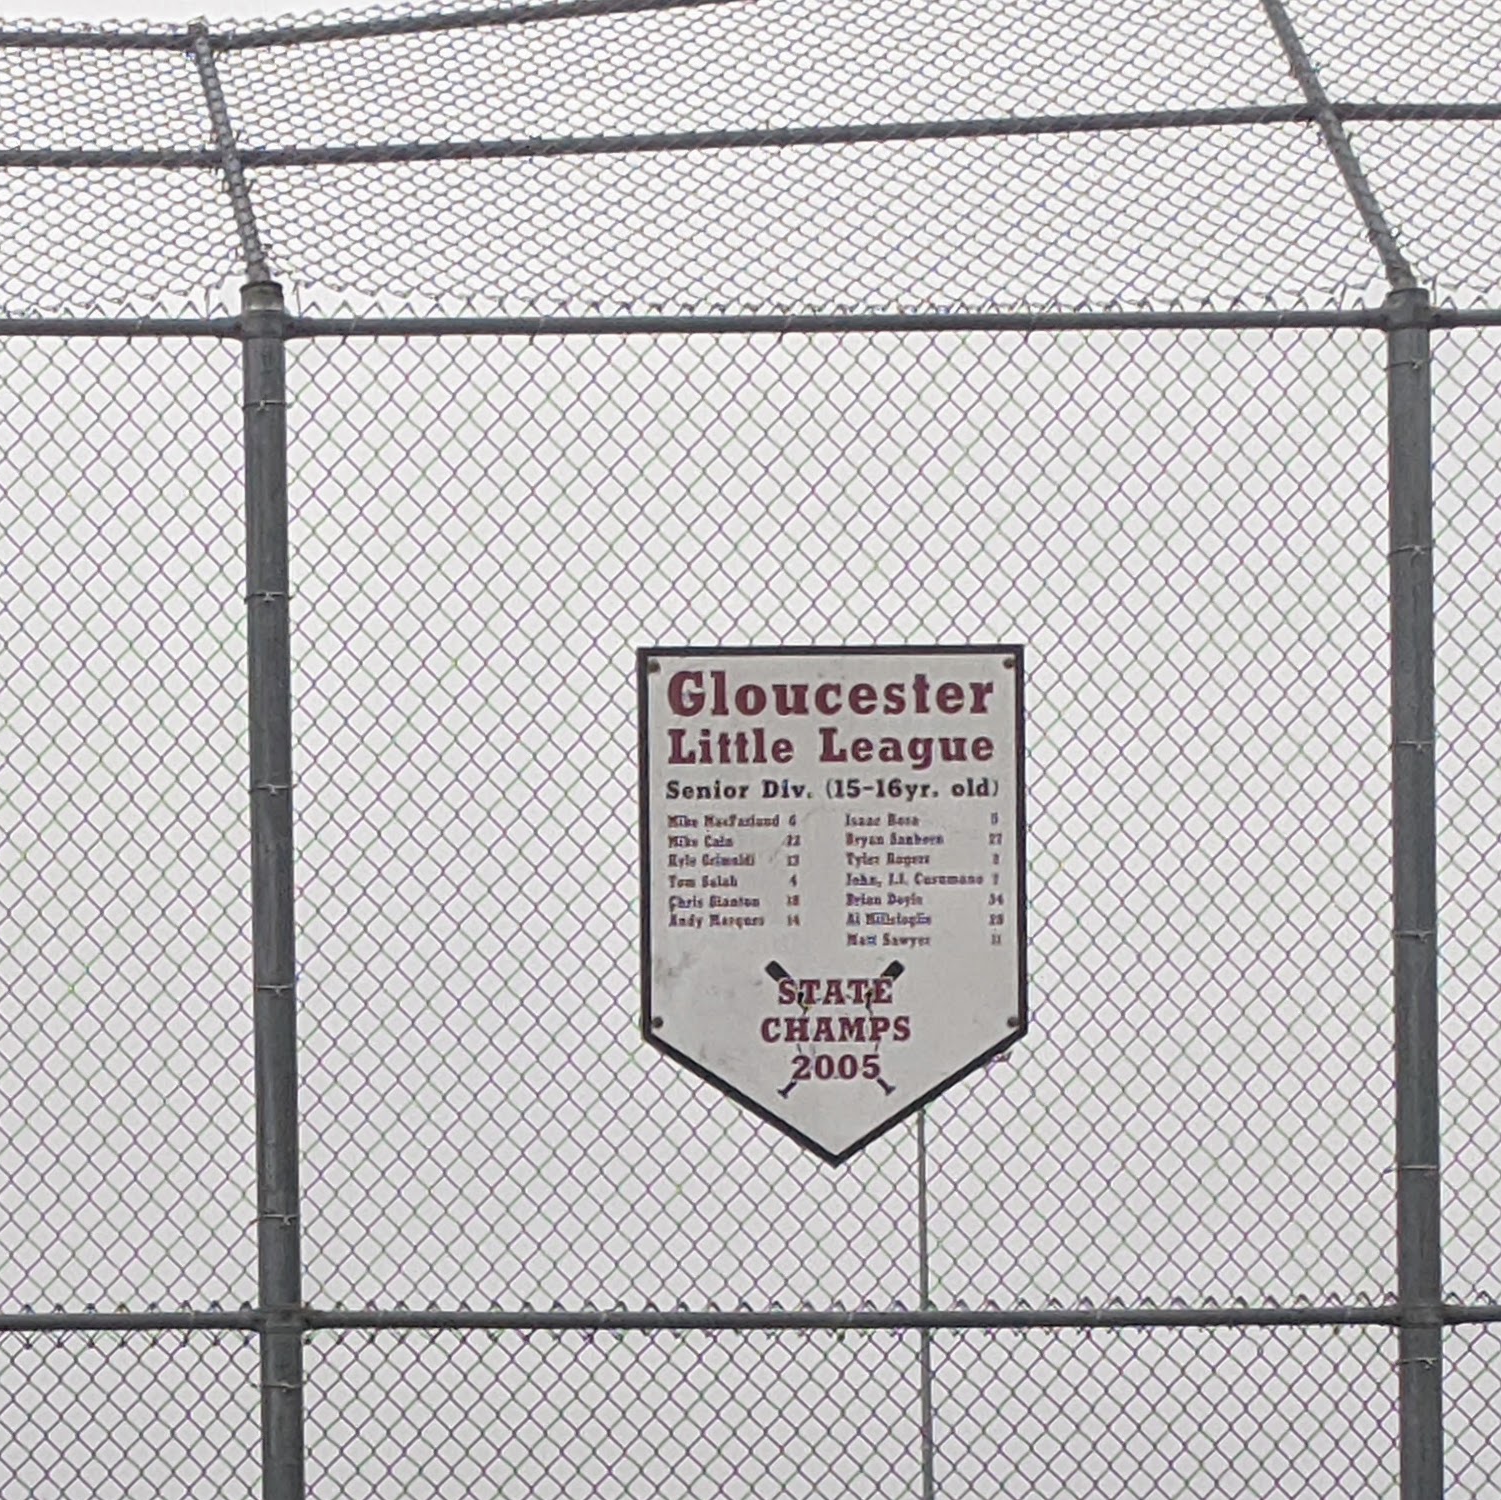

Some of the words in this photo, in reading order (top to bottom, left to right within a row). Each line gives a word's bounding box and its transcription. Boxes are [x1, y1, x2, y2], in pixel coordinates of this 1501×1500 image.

[667, 670, 994, 717] Gloucester
[667, 727, 794, 764] Little
[819, 727, 994, 770] League
[666, 779, 749, 800] Senior
[762, 779, 813, 799] Div.
[826, 778, 939, 802] (15-16yr.
[951, 777, 999, 798] old)
[667, 815, 698, 828] Mike
[668, 835, 698, 848] Mike
[668, 875, 696, 888] Tom
[846, 893, 882, 906] Brian
[669, 914, 703, 929] Andy
[778, 978, 893, 1004] STATE
[761, 1016, 911, 1043] CHAMPS
[791, 1054, 880, 1080] 2005
